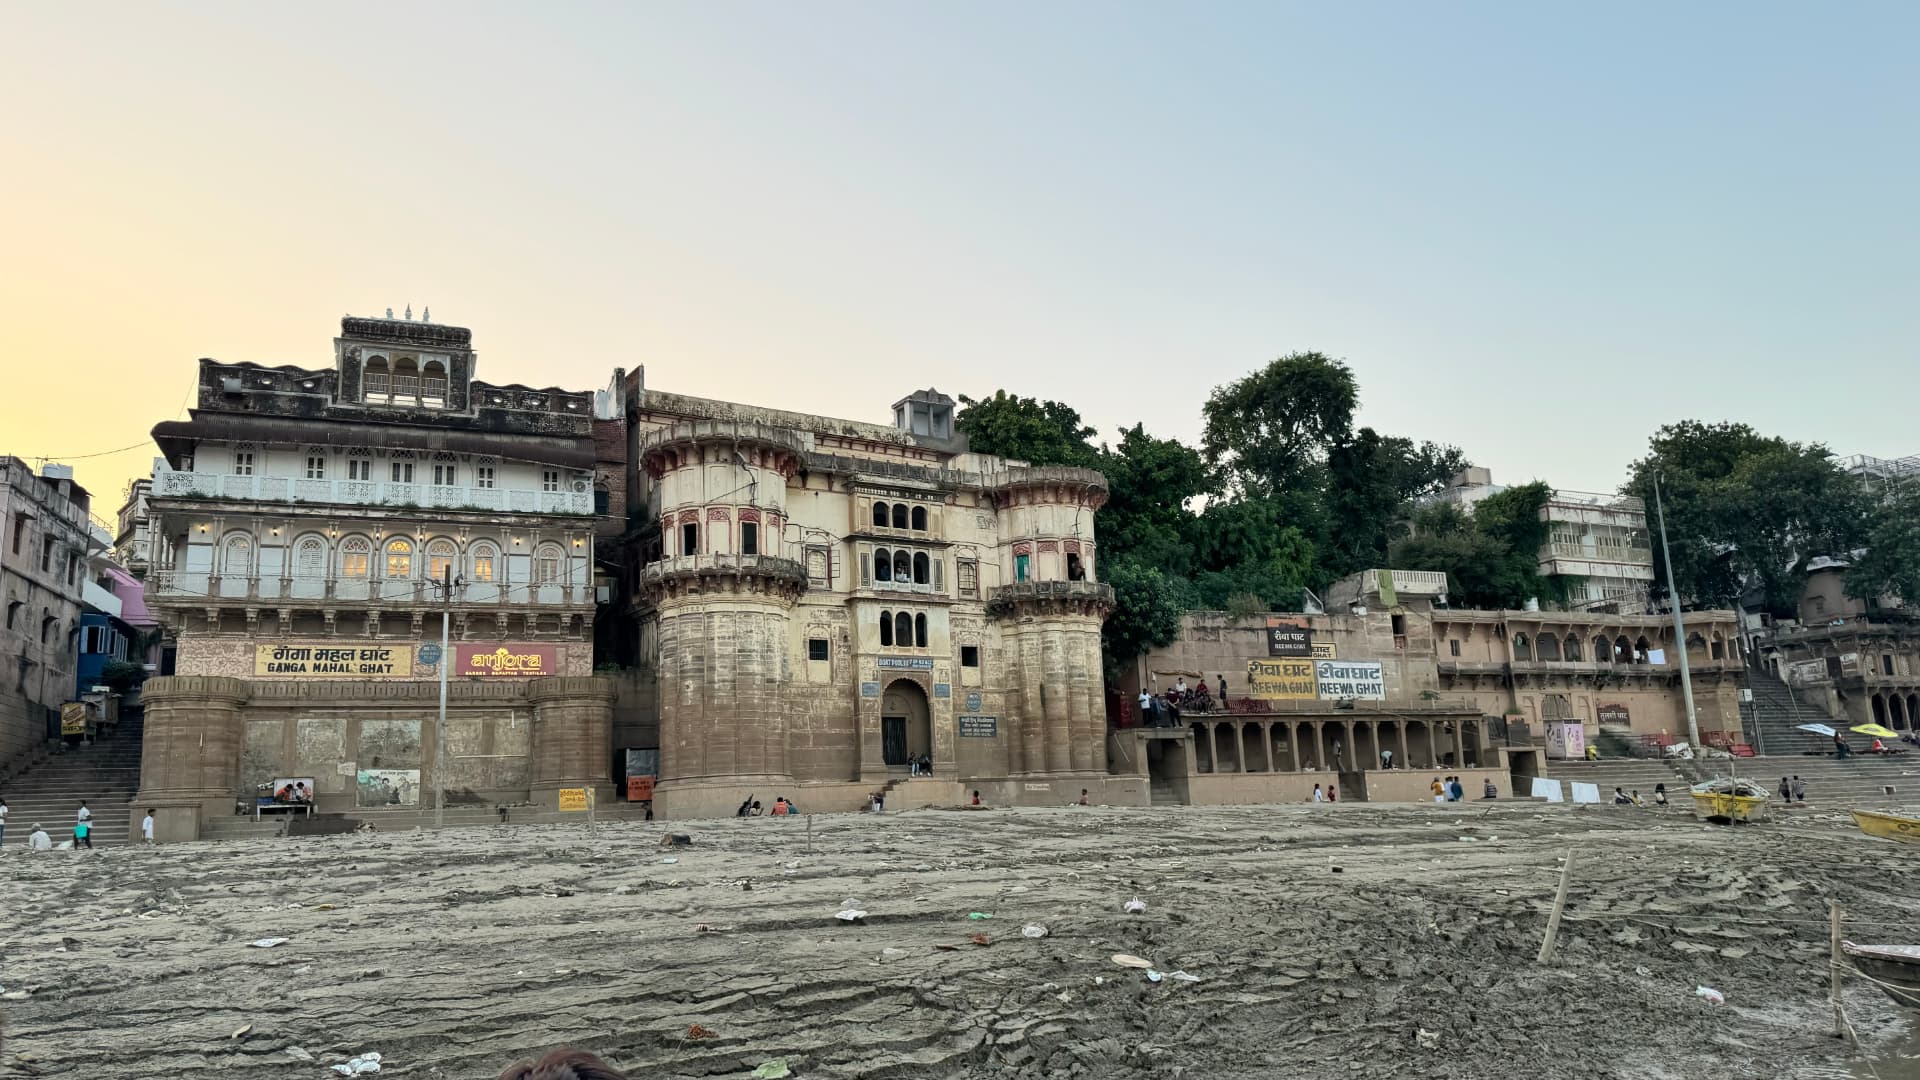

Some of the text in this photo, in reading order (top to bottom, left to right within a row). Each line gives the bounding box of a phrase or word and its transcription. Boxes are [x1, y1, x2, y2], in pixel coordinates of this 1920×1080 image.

[273, 645, 393, 662] गंगा महल घाट
[267, 662, 394, 674] GANGA MAHAL GHAT
[471, 651, 542, 671] anjora
[1282, 663, 1313, 677] घाट
[1318, 662, 1380, 680] रीवा घाट
[1289, 681, 1314, 694] GHAT
[1320, 683, 1382, 695] REEWA GHAT
